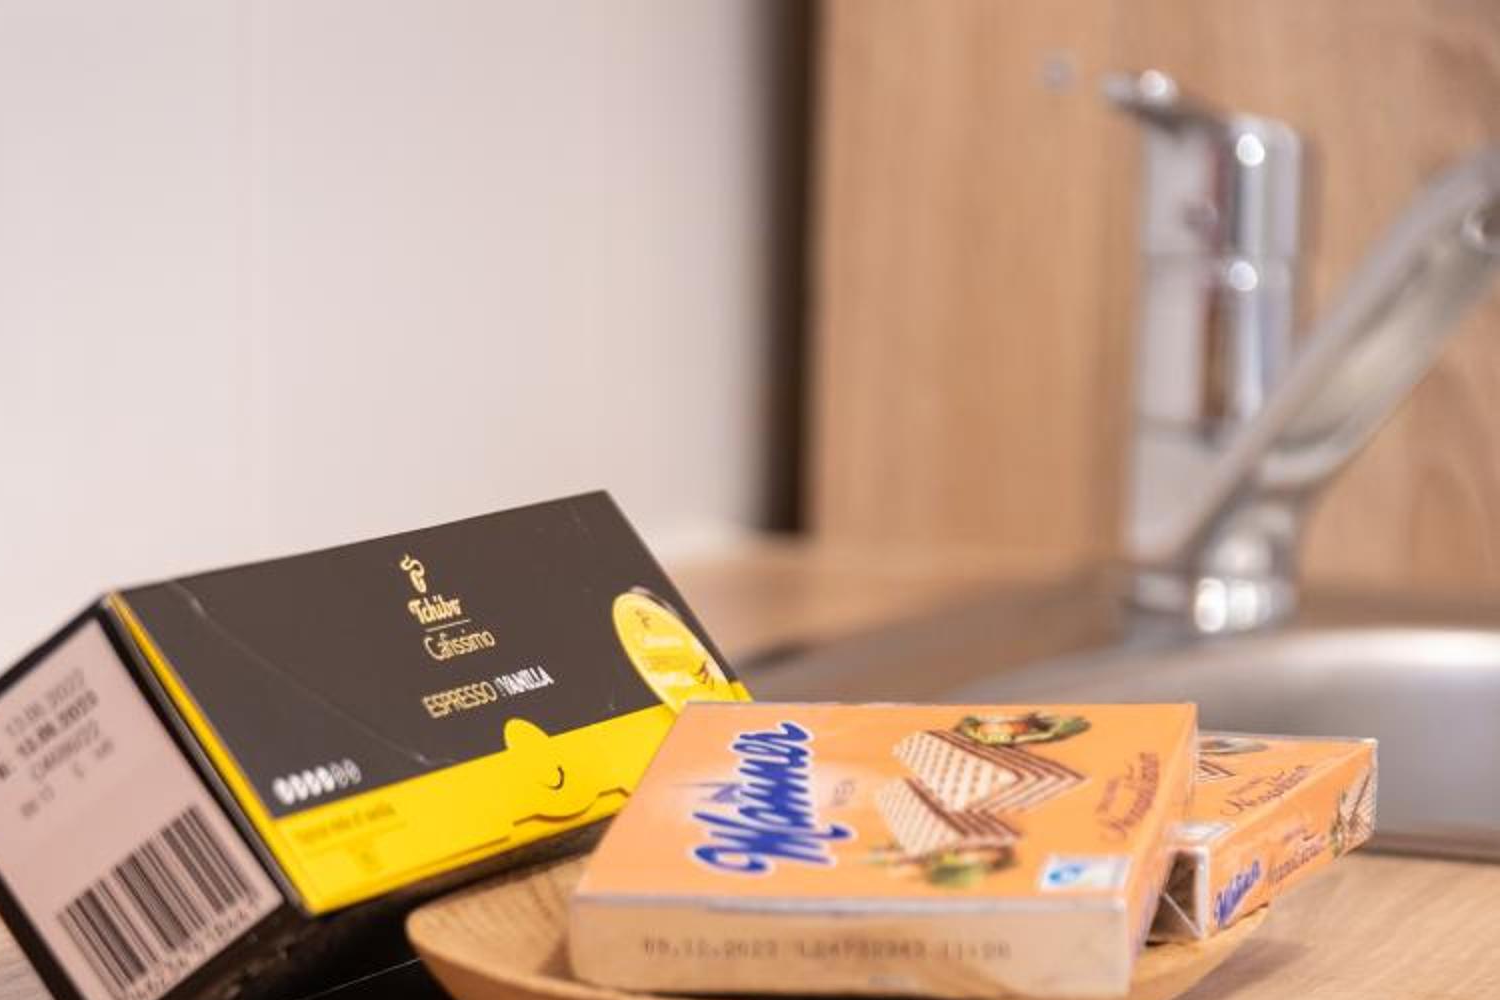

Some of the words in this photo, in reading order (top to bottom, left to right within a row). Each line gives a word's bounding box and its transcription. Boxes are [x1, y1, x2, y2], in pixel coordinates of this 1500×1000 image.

[407, 594, 462, 625] Tchibo
[424, 629, 496, 661] Cafissimo
[422, 681, 498, 719] ESPRESSO
[496, 664, 555, 697] VANILLA
[690, 720, 853, 874] Manner
